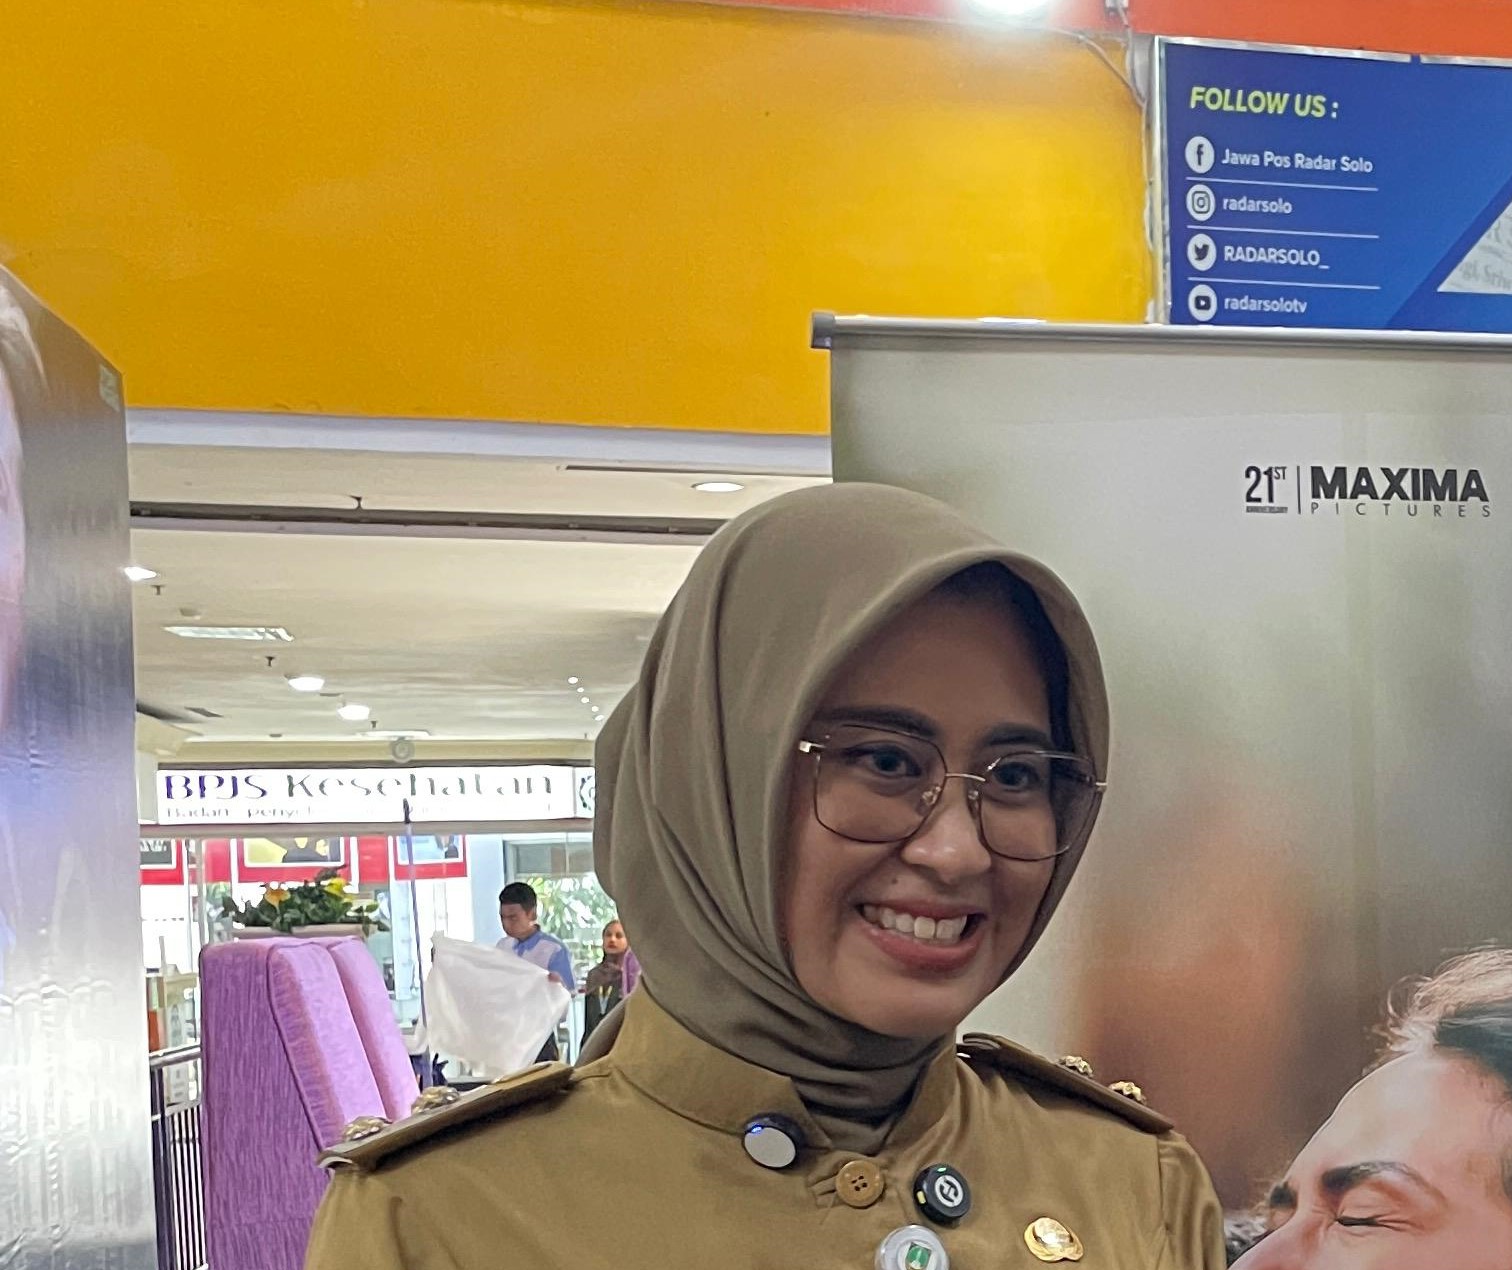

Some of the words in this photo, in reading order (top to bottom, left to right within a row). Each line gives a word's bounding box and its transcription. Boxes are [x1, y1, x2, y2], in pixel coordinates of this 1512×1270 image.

[1190, 86, 1289, 115] FOLLOW
[1294, 93, 1327, 118] US
[1221, 148, 1260, 167] Jawa
[1263, 150, 1291, 168] Pos
[1294, 152, 1336, 171] Radar
[1340, 155, 1373, 173] Solo
[1223, 196, 1293, 214] radarsolo
[1224, 245, 1330, 270] RADARSOLO_
[1224, 295, 1307, 314] radarsolotv
[1310, 465, 1489, 502] MAXIMA
[1311, 502, 1491, 518] PICTURES
[164, 773, 269, 800] BPJS
[286, 772, 553, 798] Kesehatan
